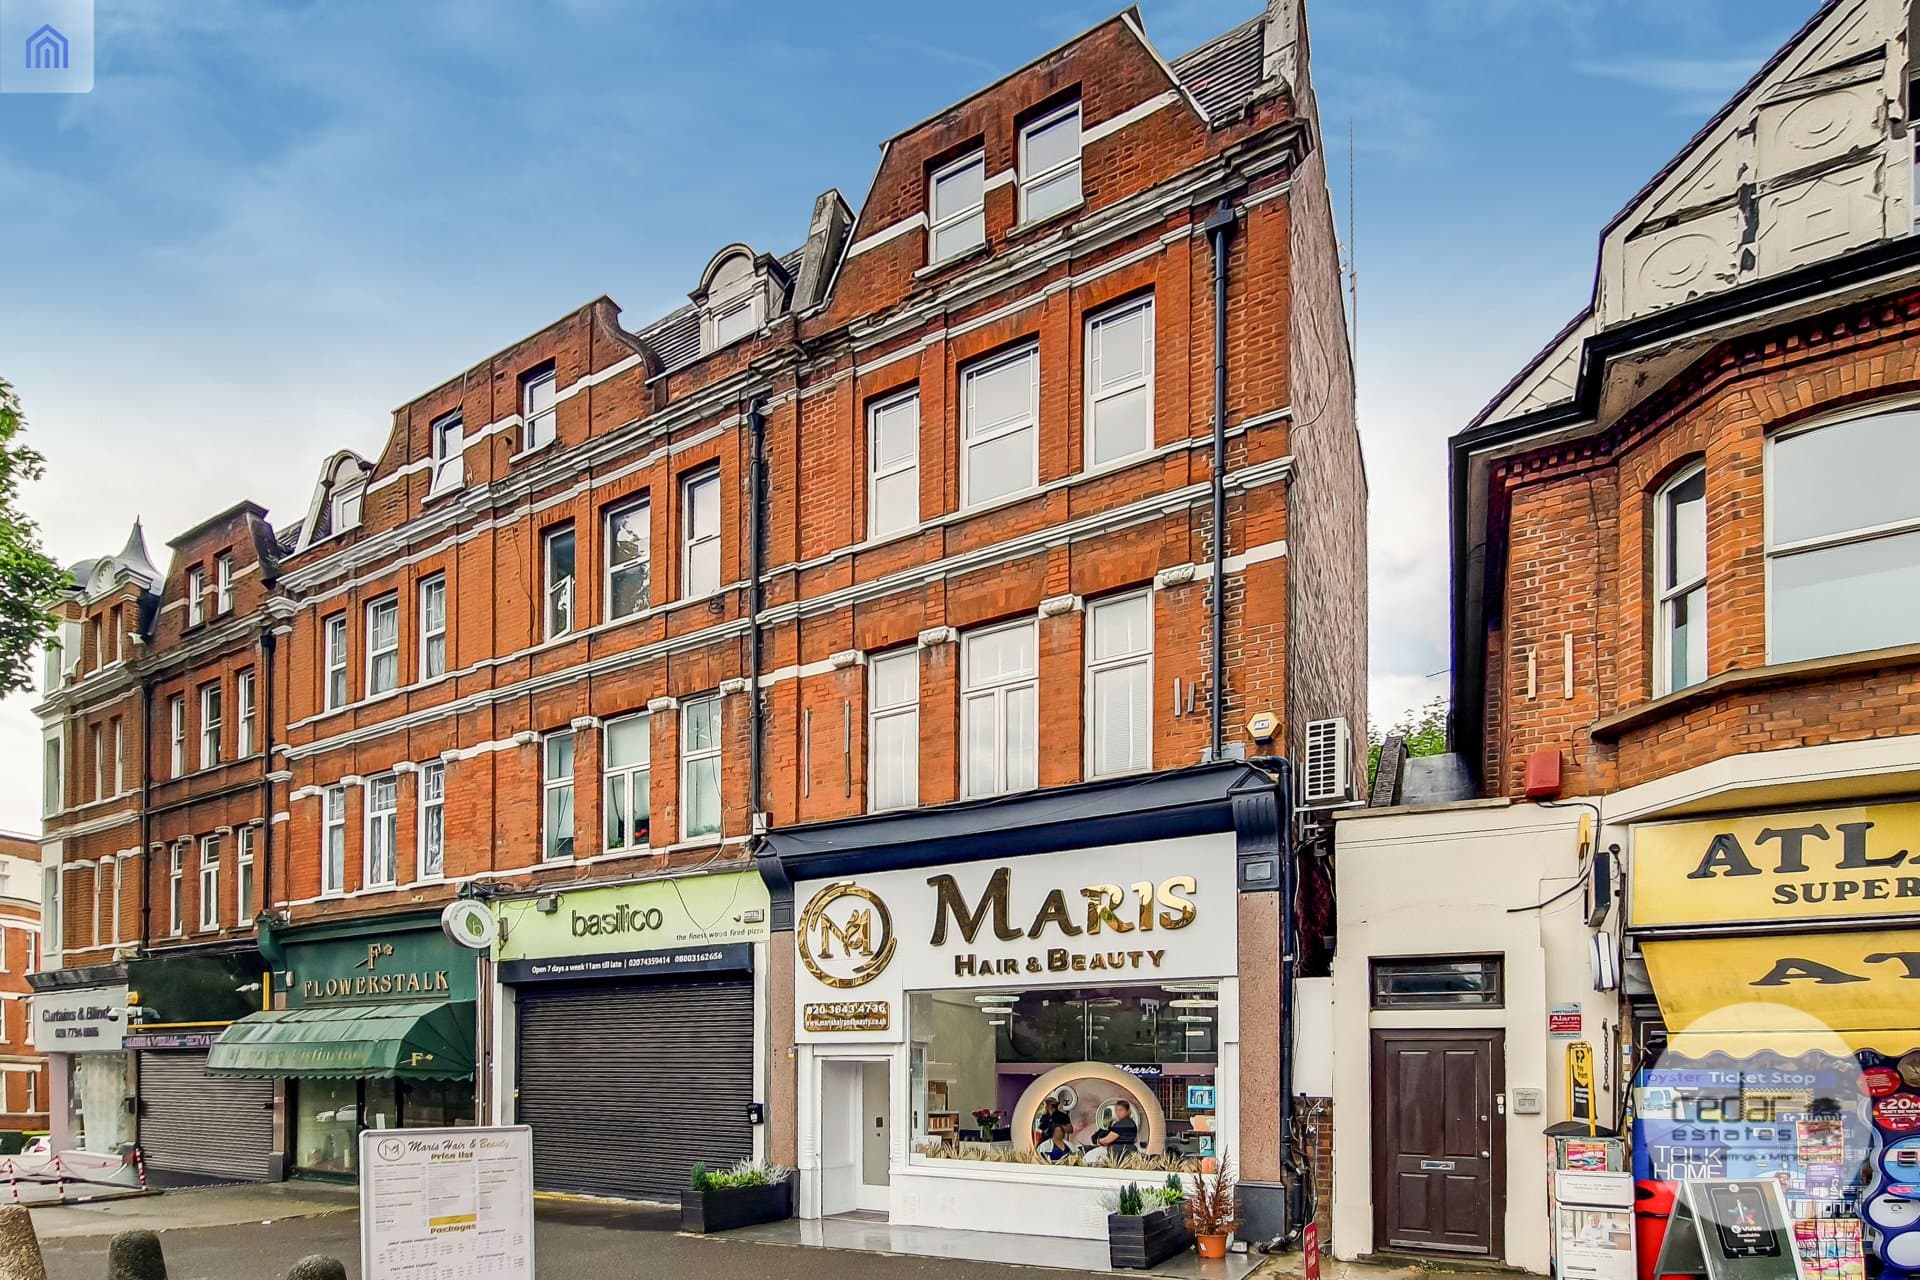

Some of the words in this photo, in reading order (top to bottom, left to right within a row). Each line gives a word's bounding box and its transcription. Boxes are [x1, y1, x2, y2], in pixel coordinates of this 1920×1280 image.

[1687, 821, 1920, 880] ATL
[571, 903, 663, 937] basilico
[689, 932, 706, 940] finest
[709, 930, 727, 938] wood
[730, 928, 745, 936] fired
[747, 928, 764, 936] pizza
[531, 966, 546, 975] Open
[547, 965, 551, 973] 7
[551, 965, 564, 973] days
[569, 963, 584, 971] week
[610, 960, 622, 968] late
[1025, 956, 1042, 973] &
[304, 970, 449, 998] FLOWERSTALK
[42, 1008, 76, 1022] Curtains
[78, 1007, 84, 1021] &
[86, 1005, 112, 1020] Blind
[806, 1005, 826, 1014] 020
[1708, 1071, 1767, 1083] Ticket
[1771, 1072, 1816, 1086] Stop
[408, 1141, 439, 1152] Maris
[442, 1139, 465, 1150] Hair
[1654, 1145, 1723, 1165] TALK
